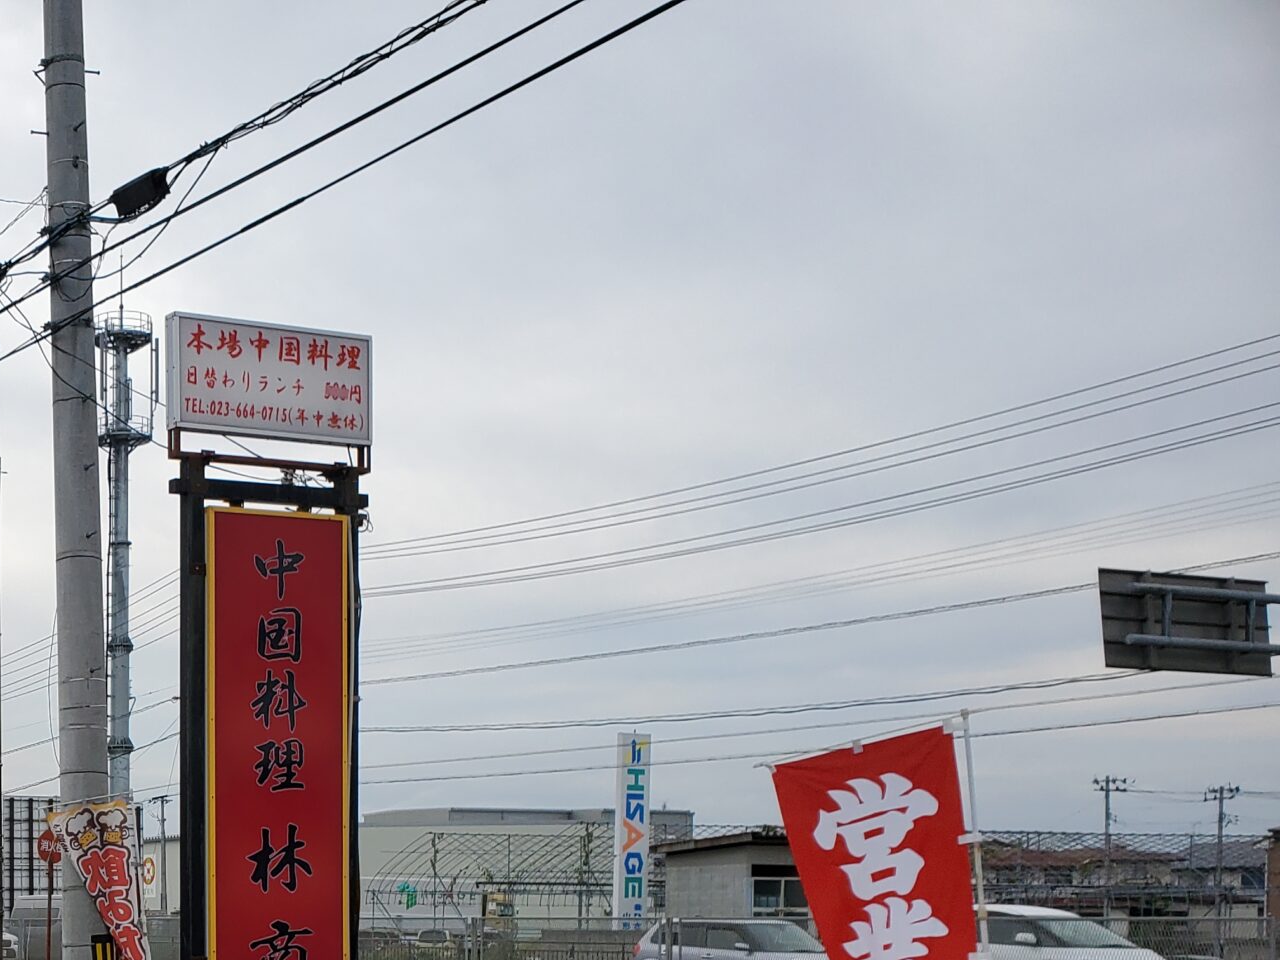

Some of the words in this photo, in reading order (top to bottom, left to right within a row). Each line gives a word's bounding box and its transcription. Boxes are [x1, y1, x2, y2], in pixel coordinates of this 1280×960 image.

[186, 323, 362, 372] 本場中国料理
[186, 365, 305, 397] 日替わりランチ
[250, 538, 308, 793] 中国料理
